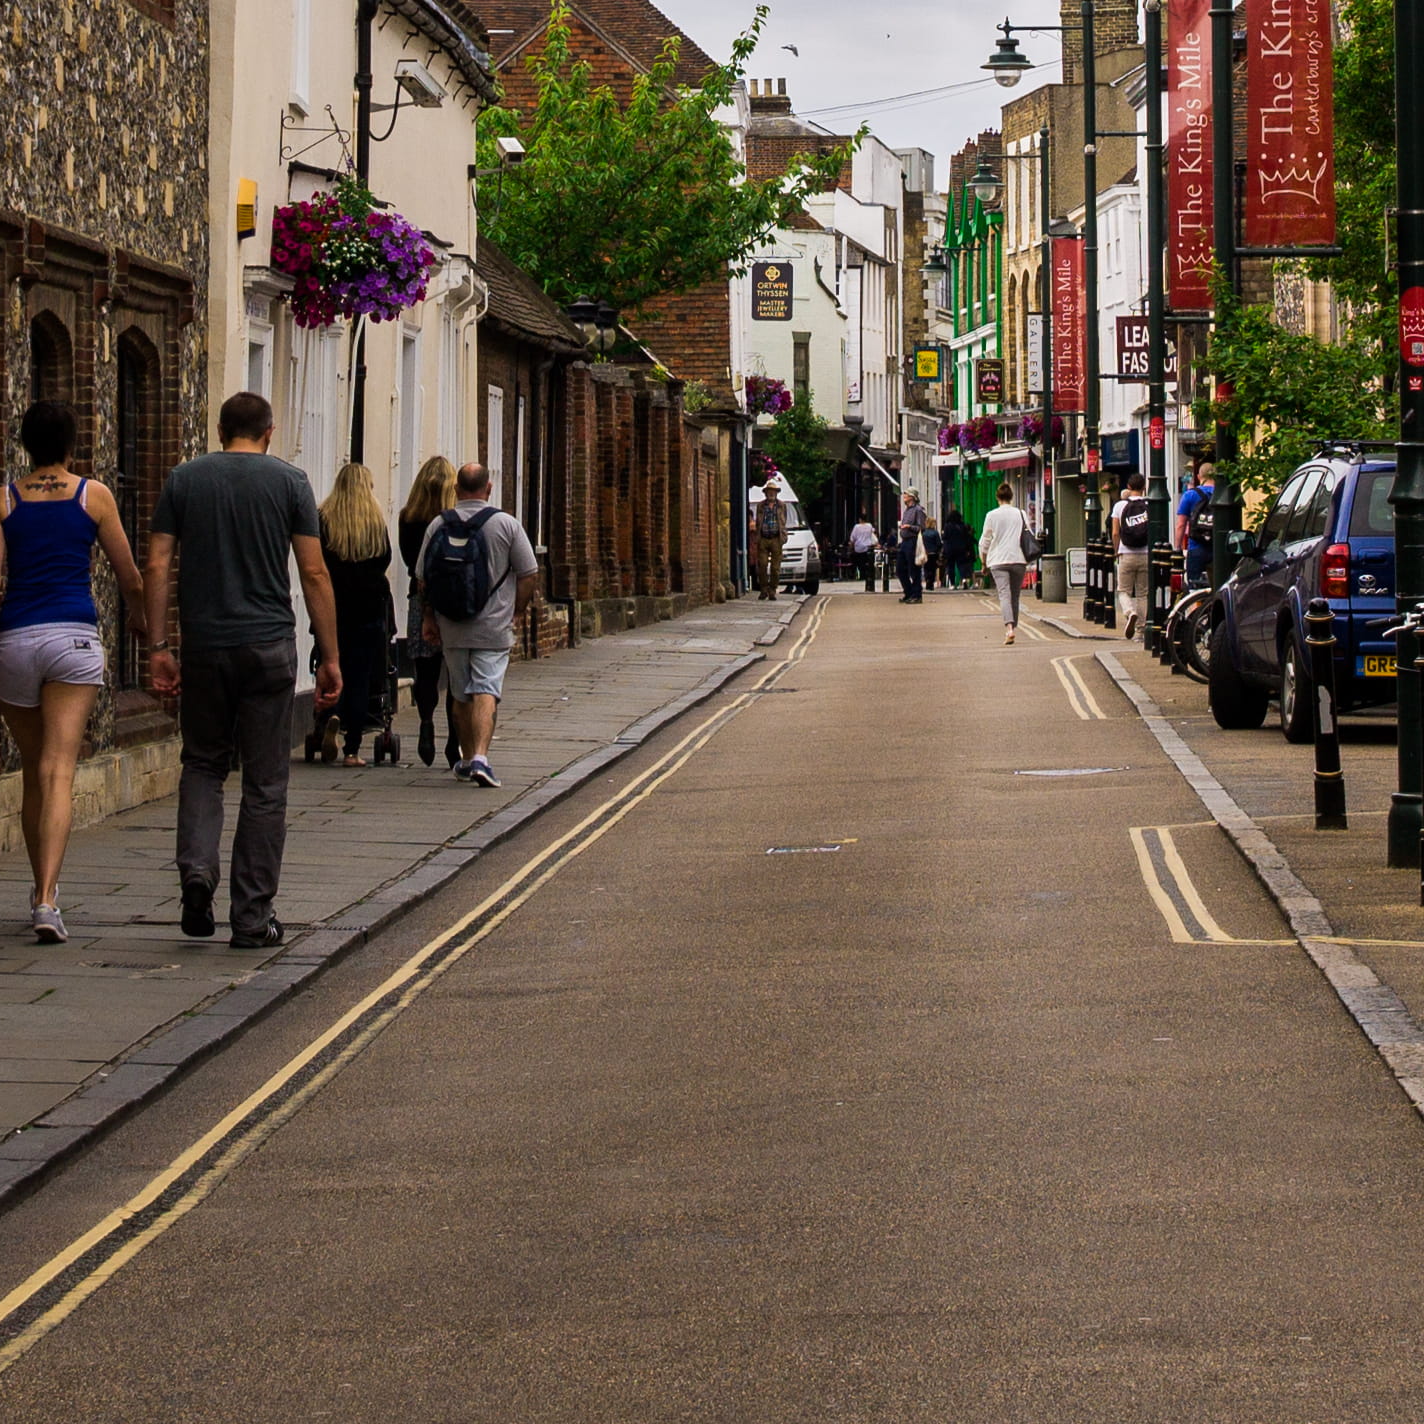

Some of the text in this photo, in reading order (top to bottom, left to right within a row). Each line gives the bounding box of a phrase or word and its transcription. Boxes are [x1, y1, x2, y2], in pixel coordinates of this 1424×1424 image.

[1176, 31, 1208, 236] The King's Mile
[1259, 72, 1293, 144] The
[1056, 258, 1074, 372] The King's Mile
[1029, 318, 1038, 388] GALLERY
[1367, 657, 1397, 673] GR5
